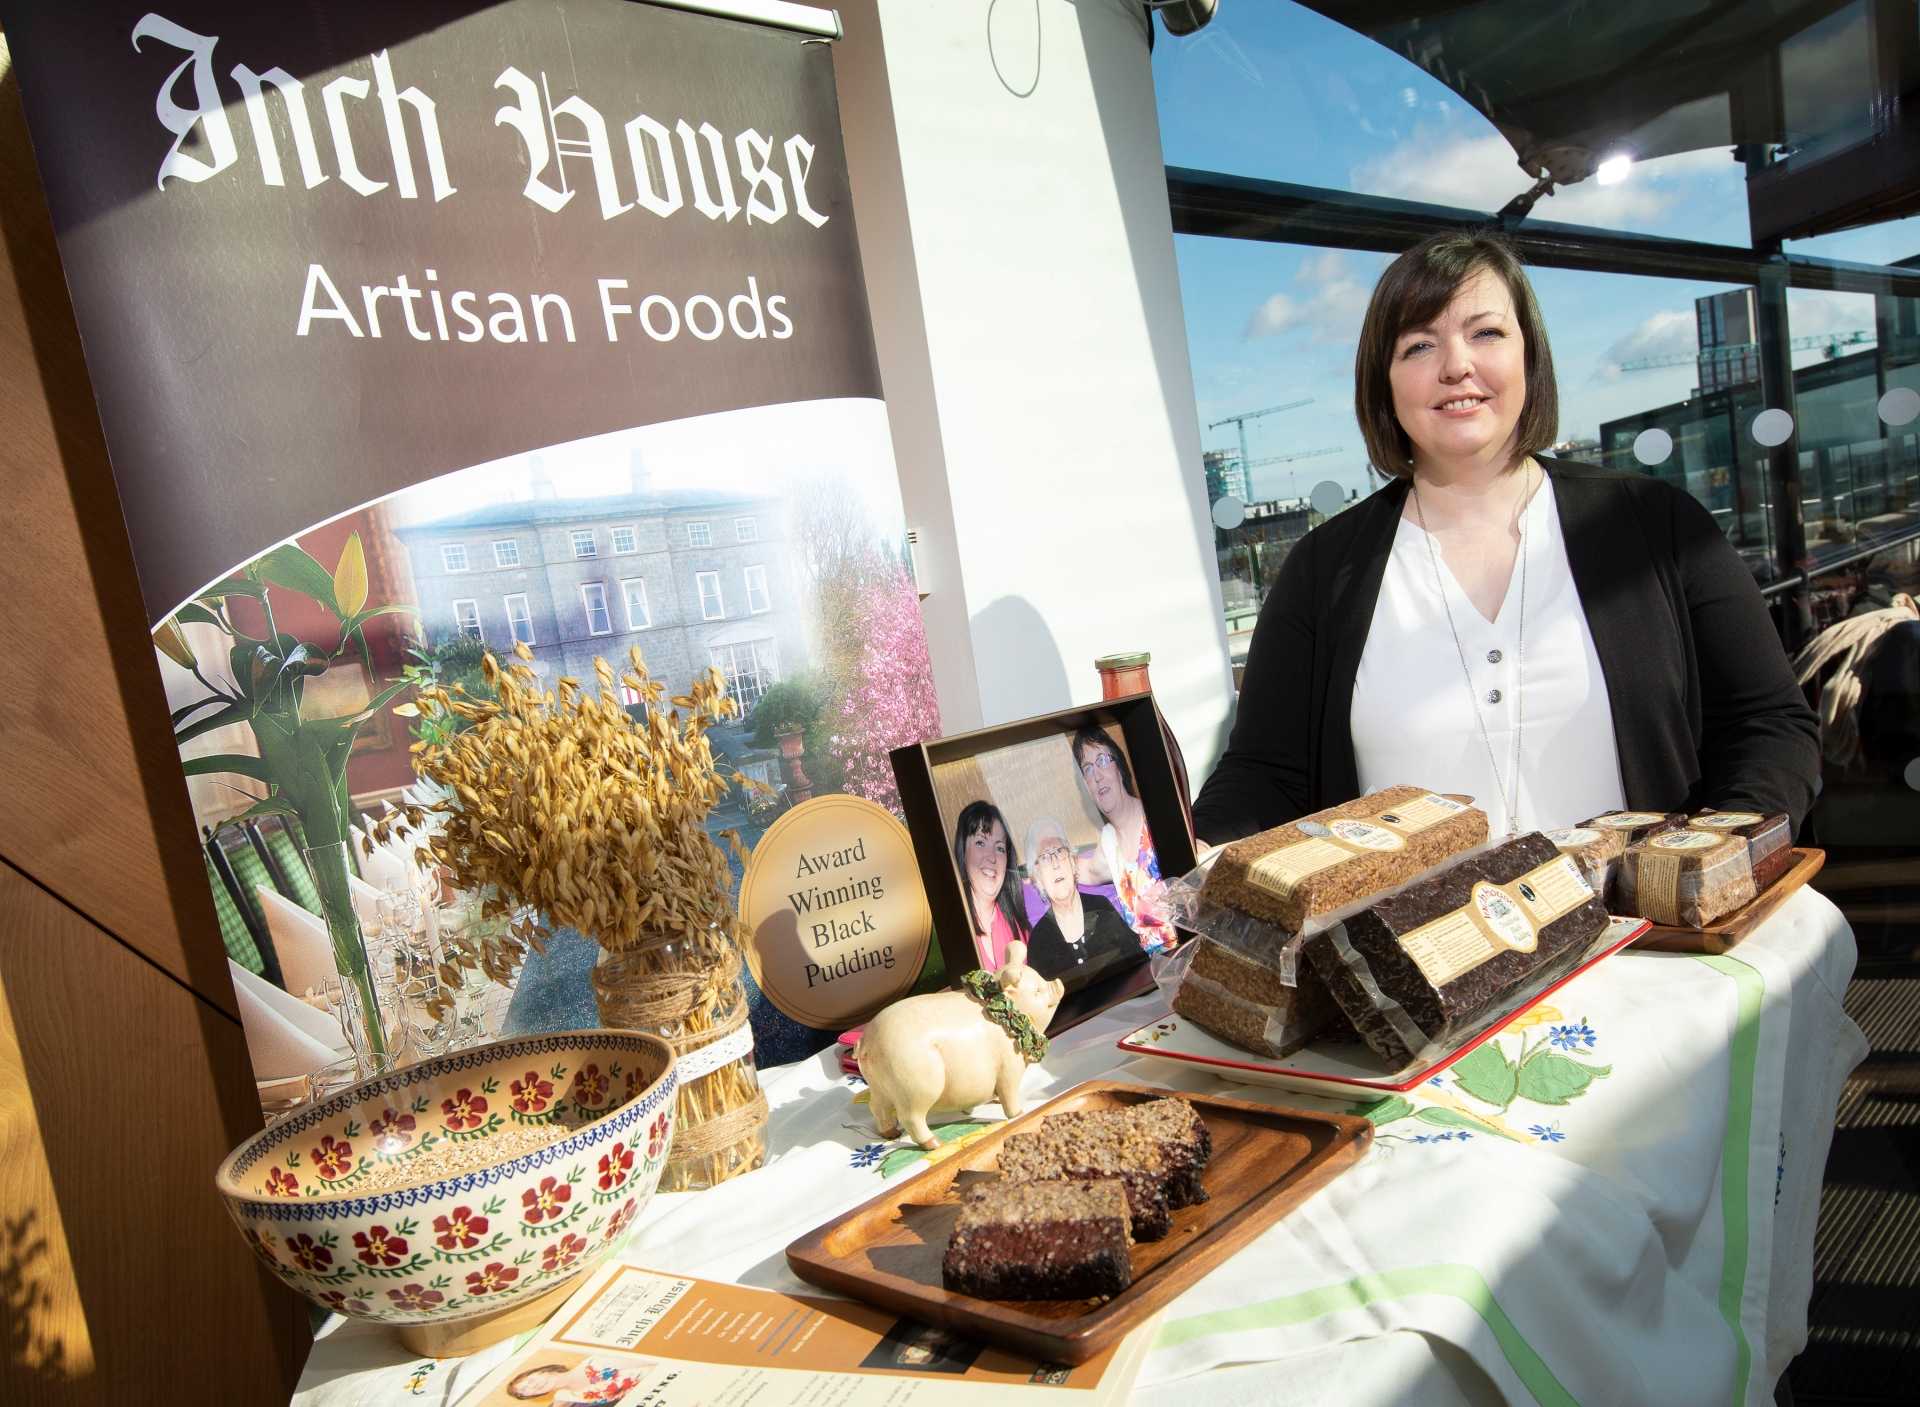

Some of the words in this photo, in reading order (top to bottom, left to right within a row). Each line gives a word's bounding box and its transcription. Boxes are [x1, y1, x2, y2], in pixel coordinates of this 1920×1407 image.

[131, 12, 458, 203] Inch
[494, 66, 830, 228] House
[297, 263, 577, 343] Artisan
[598, 276, 794, 342] Foods
[795, 837, 867, 879] Award
[787, 875, 885, 916] Winning
[810, 910, 877, 949] Black
[804, 945, 896, 989] Pudding
[615, 1318, 653, 1346] Inch
[644, 1280, 689, 1315] House
